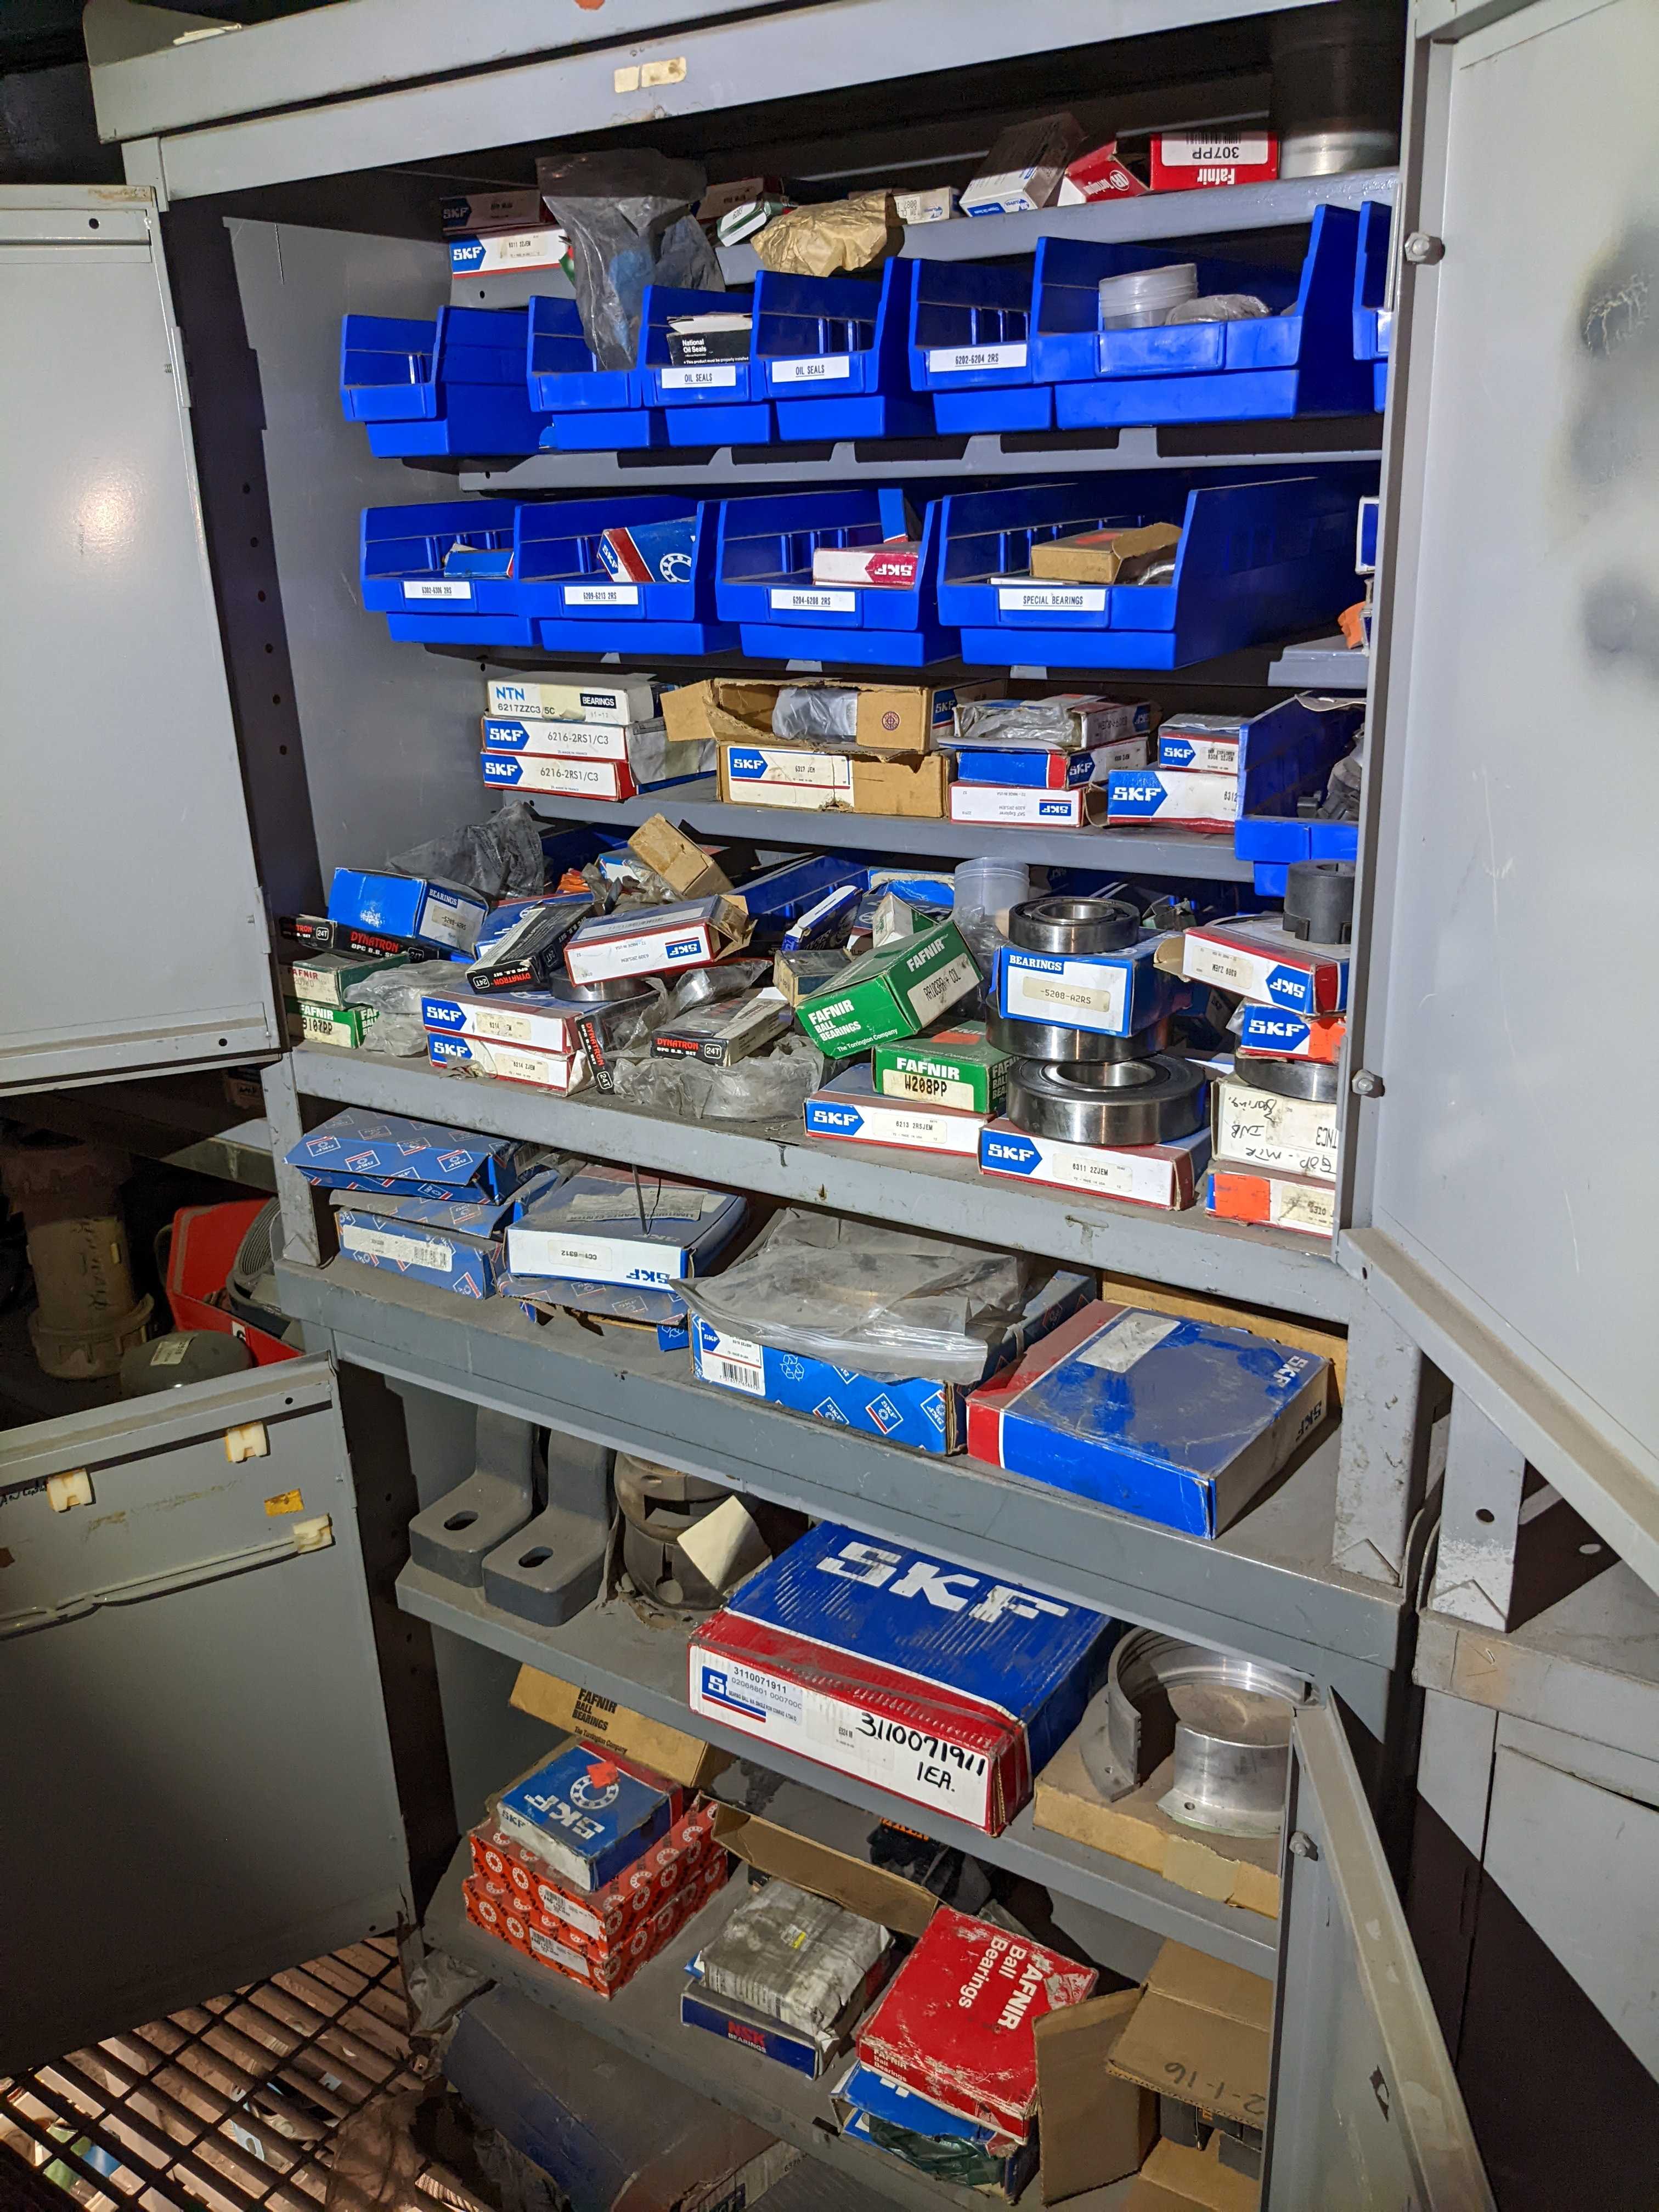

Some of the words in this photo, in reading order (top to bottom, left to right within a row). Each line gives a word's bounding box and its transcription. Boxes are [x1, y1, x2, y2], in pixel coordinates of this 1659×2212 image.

[1192, 146, 1239, 159] 307PP
[1197, 168, 1235, 185] Fafnir
[443, 207, 469, 219] SKF
[453, 246, 482, 261] SKF
[955, 354, 985, 365] 6202-6204
[988, 353, 998, 363] 2RS
[685, 374, 693, 382] OIL
[696, 373, 712, 382] SEALS
[795, 366, 805, 375] OIL
[807, 364, 825, 374] SEALS
[602, 545, 618, 574] SKF
[874, 563, 912, 577] SKF
[583, 592, 606, 601] 6209-6213
[608, 592, 617, 600] 2RS
[793, 595, 819, 606] 6204-6208
[821, 596, 831, 606] 2RS
[1023, 595, 1049, 606] SPECIAL
[1051, 595, 1084, 607] BEARINGS
[495, 686, 525, 701] NTN
[582, 696, 614, 707] BEARINGS
[935, 699, 955, 713] SKF
[489, 729, 523, 742] SKF
[548, 731, 609, 745] 6216-2RS1/C3
[1164, 747, 1193, 758] SKF
[485, 763, 518, 776] SKF
[733, 759, 764, 770] SKF
[1069, 762, 1092, 776] SKF
[540, 767, 599, 782] 6216-2RS1/C3
[1113, 787, 1161, 801] SKF
[1041, 805, 1069, 814] SKF
[430, 889, 457, 906] BEARINGS
[317, 929, 328, 938] 24T
[350, 931, 399, 953] DYNATRON
[351, 943, 365, 952] OPC
[669, 943, 698, 956] SKF
[906, 938, 946, 972] FAFNIR
[1009, 954, 1062, 972] BEARINGS
[476, 979, 488, 988] 24T
[494, 972, 531, 986] DYNATRON
[1269, 978, 1306, 998] SKF
[1040, 988, 1091, 1005] -5208-A2RS
[426, 1006, 462, 1022] SKF
[808, 998, 855, 1024] FAFNIR
[814, 1021, 837, 1035] BALL
[819, 1020, 862, 1042] BEARINGS
[1248, 1018, 1305, 1037] SKF
[585, 1022, 605, 1066] DYNATRON
[656, 1037, 699, 1051] DYNATRON
[837, 1045, 848, 1053] The
[848, 1036, 878, 1051] Torrington
[878, 1028, 898, 1042] Company
[434, 1042, 467, 1058] SKF
[706, 1047, 720, 1056] 24T
[896, 1057, 960, 1080] FAFNIR
[599, 1073, 611, 1088] 24T
[905, 1074, 947, 1097] W208PP
[814, 1110, 858, 1127] SKF
[912, 1122, 933, 1131] 2RSJEM
[988, 1143, 1035, 1162] SKF
[1090, 1166, 1108, 1176] 2ZJEM
[626, 1268, 670, 1284] SKF
[704, 1334, 719, 1342] SKF
[1273, 1355, 1308, 1388] SKF
[827, 1403, 844, 1423] SKF
[881, 1400, 898, 1420] SKF
[927, 1405, 944, 1425] SKF
[1296, 1400, 1322, 1442] SKF
[816, 1541, 1069, 1623] SKF
[732, 1677, 767, 1696] 02068801
[733, 1667, 786, 1694] 3110071911
[575, 1700, 592, 1714] BALL
[578, 1687, 618, 1714] FAFNIR
[572, 1708, 609, 1731] BEARINGS
[838, 1726, 848, 1737] 6324
[574, 1725, 583, 1735] The
[606, 1740, 628, 1755] Company
[855, 1712, 986, 1776] 3110071911
[502, 1808, 526, 1829] SKF
[523, 1793, 606, 1841] SKF
[998, 1944, 1028, 1980] Ball
[958, 1934, 1009, 2008] Bearings
[997, 1962, 1045, 2030] AFNIR
[728, 2020, 765, 2048] NSK
[728, 2033, 767, 2054] BEARINGS
[873, 2047, 907, 2070] FAFNIR
[874, 2055, 888, 2069] Ball
[873, 2061, 908, 2083] Bearings
